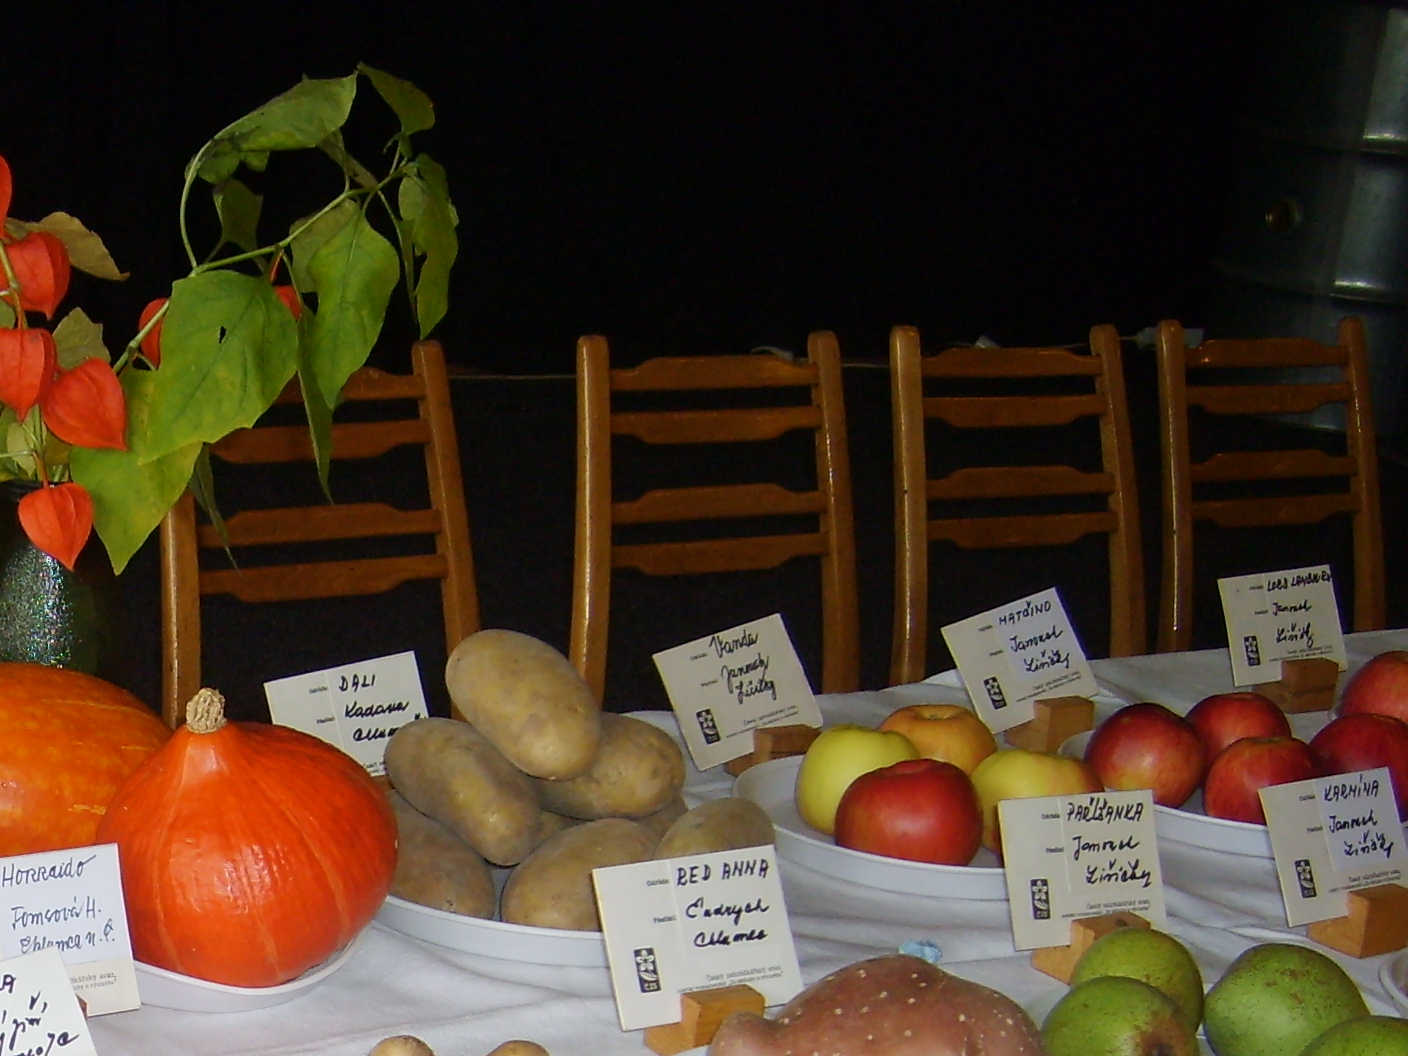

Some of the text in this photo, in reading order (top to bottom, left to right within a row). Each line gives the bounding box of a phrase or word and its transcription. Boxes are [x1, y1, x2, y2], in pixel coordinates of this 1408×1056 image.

[339, 673, 376, 693] DALI
[677, 858, 770, 886] RED ANNA
